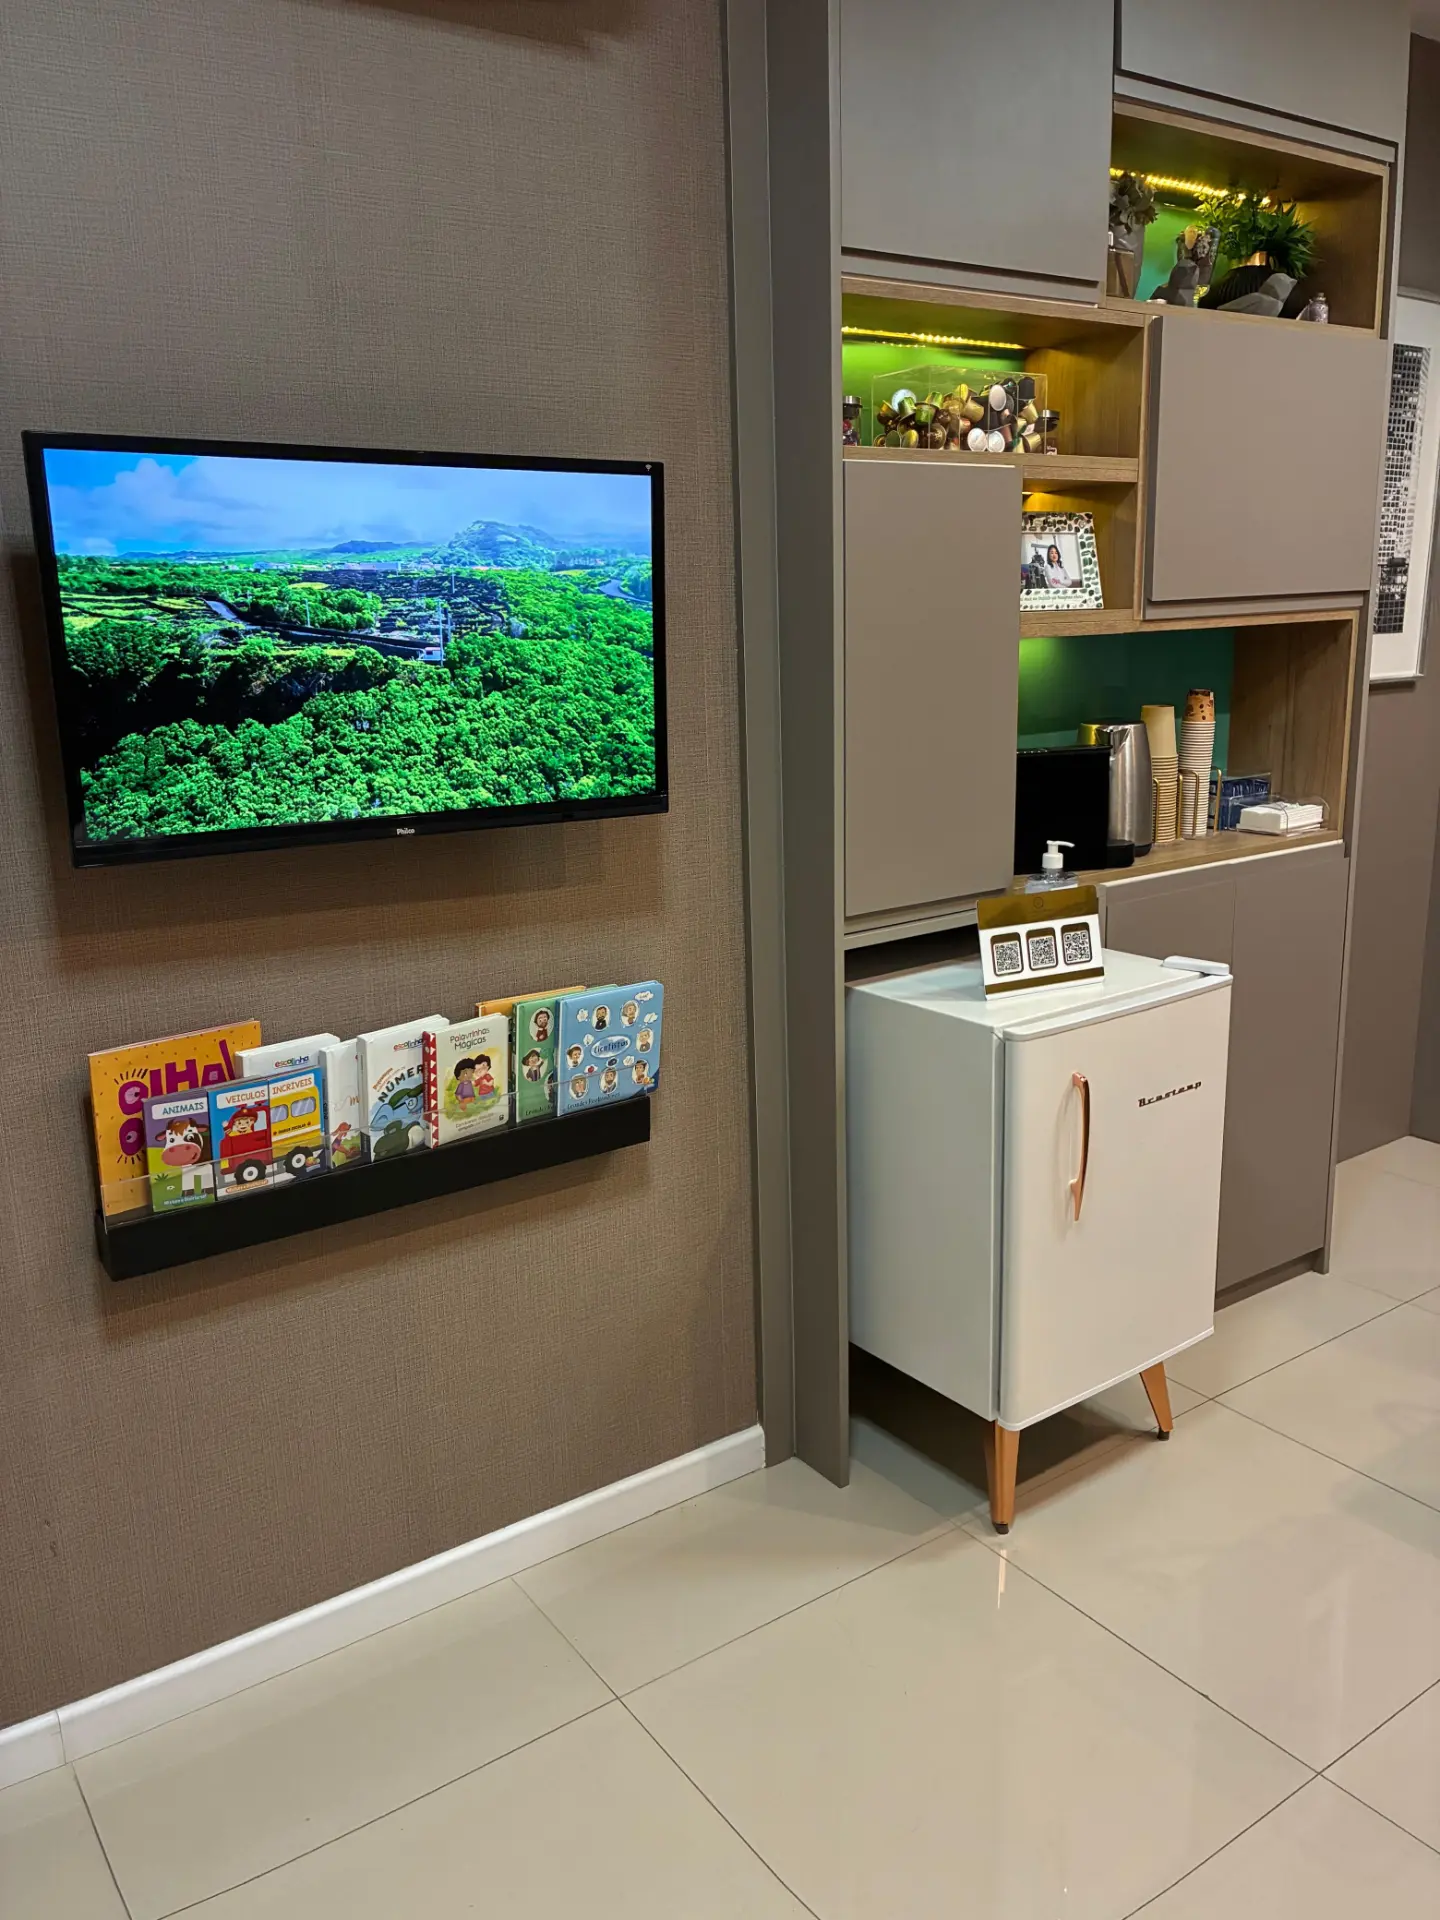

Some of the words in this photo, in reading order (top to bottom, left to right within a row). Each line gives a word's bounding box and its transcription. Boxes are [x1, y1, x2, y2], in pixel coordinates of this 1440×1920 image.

[449, 1027, 491, 1044] Palavrinhas
[1137, 1080, 1202, 1108] Brastemp
[162, 1102, 205, 1116] ANIMAIS
